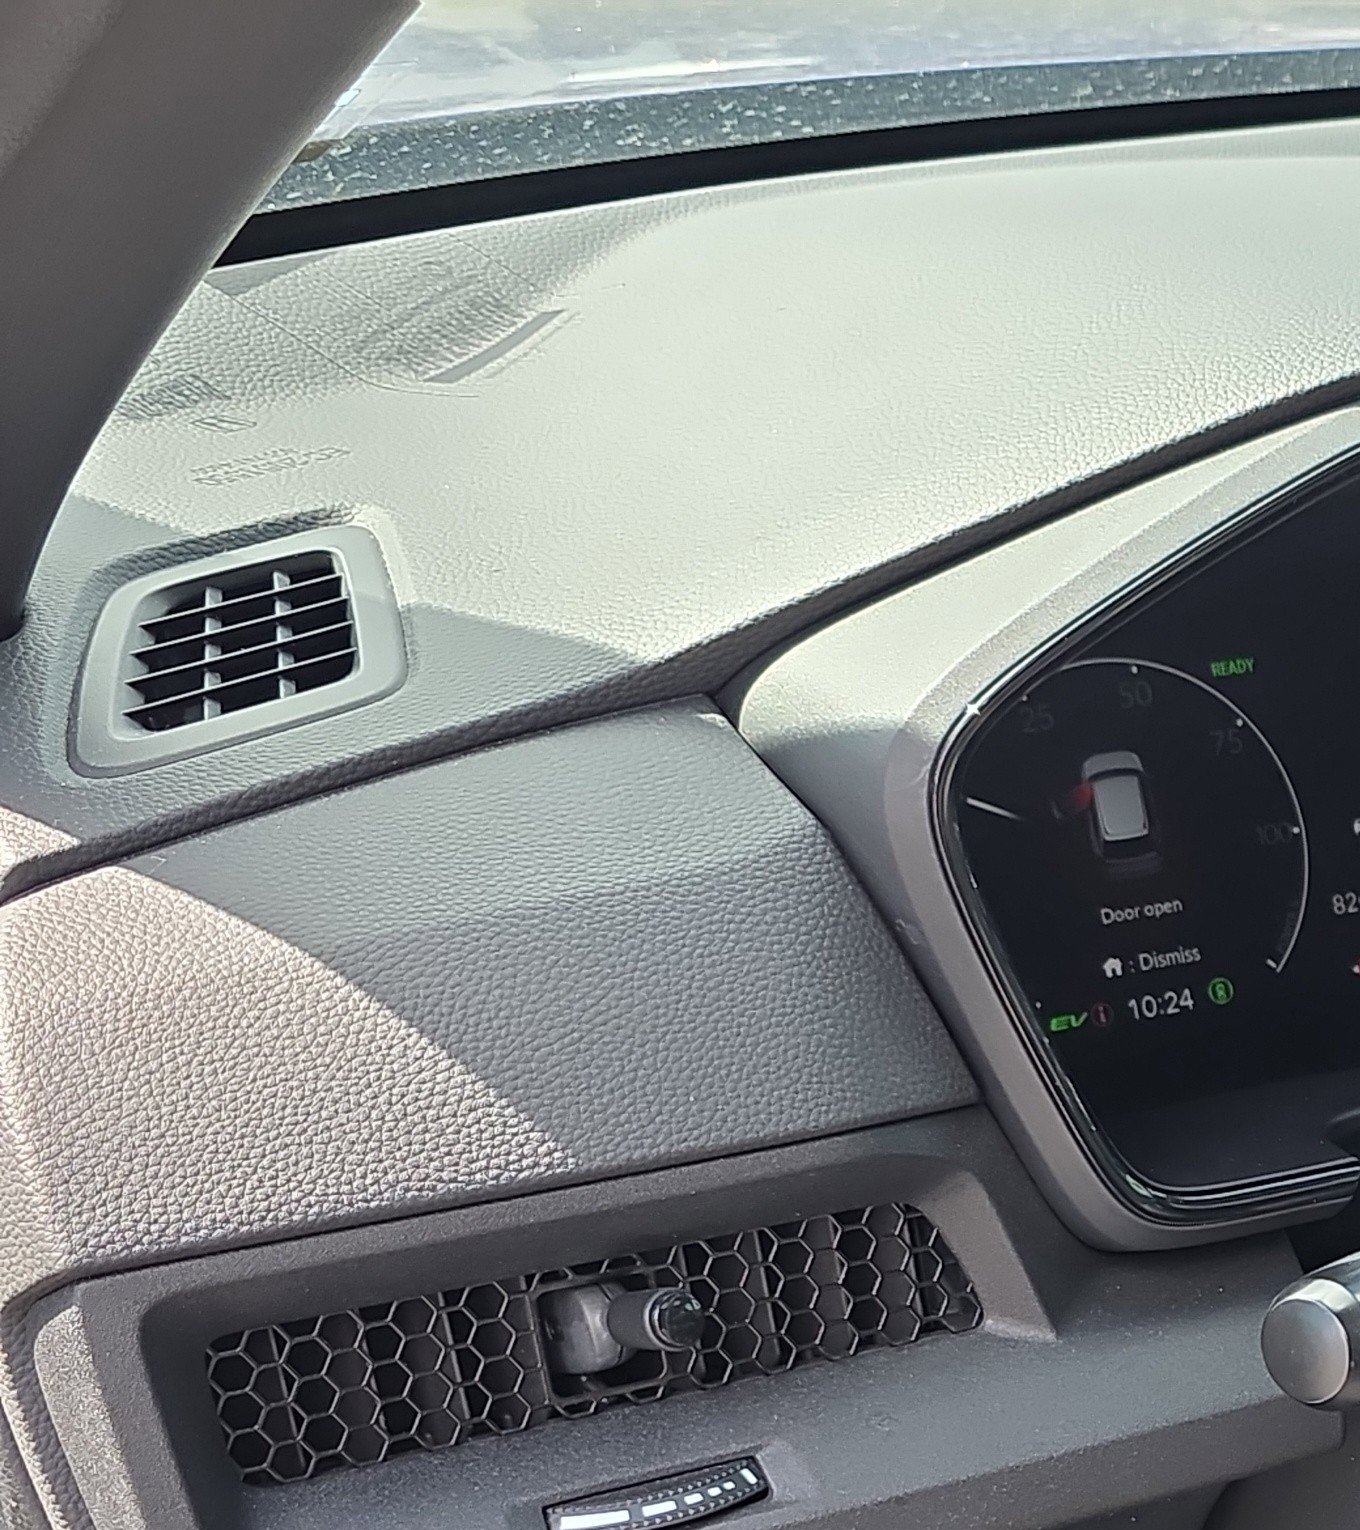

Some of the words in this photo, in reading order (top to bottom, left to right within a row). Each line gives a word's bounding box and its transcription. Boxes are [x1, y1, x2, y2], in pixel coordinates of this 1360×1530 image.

[1210, 658, 1255, 677] READY
[1101, 905, 1140, 925] Door
[1144, 899, 1184, 919] open
[1138, 946, 1202, 972] Dismiss
[1127, 988, 1195, 1021] 10:24
